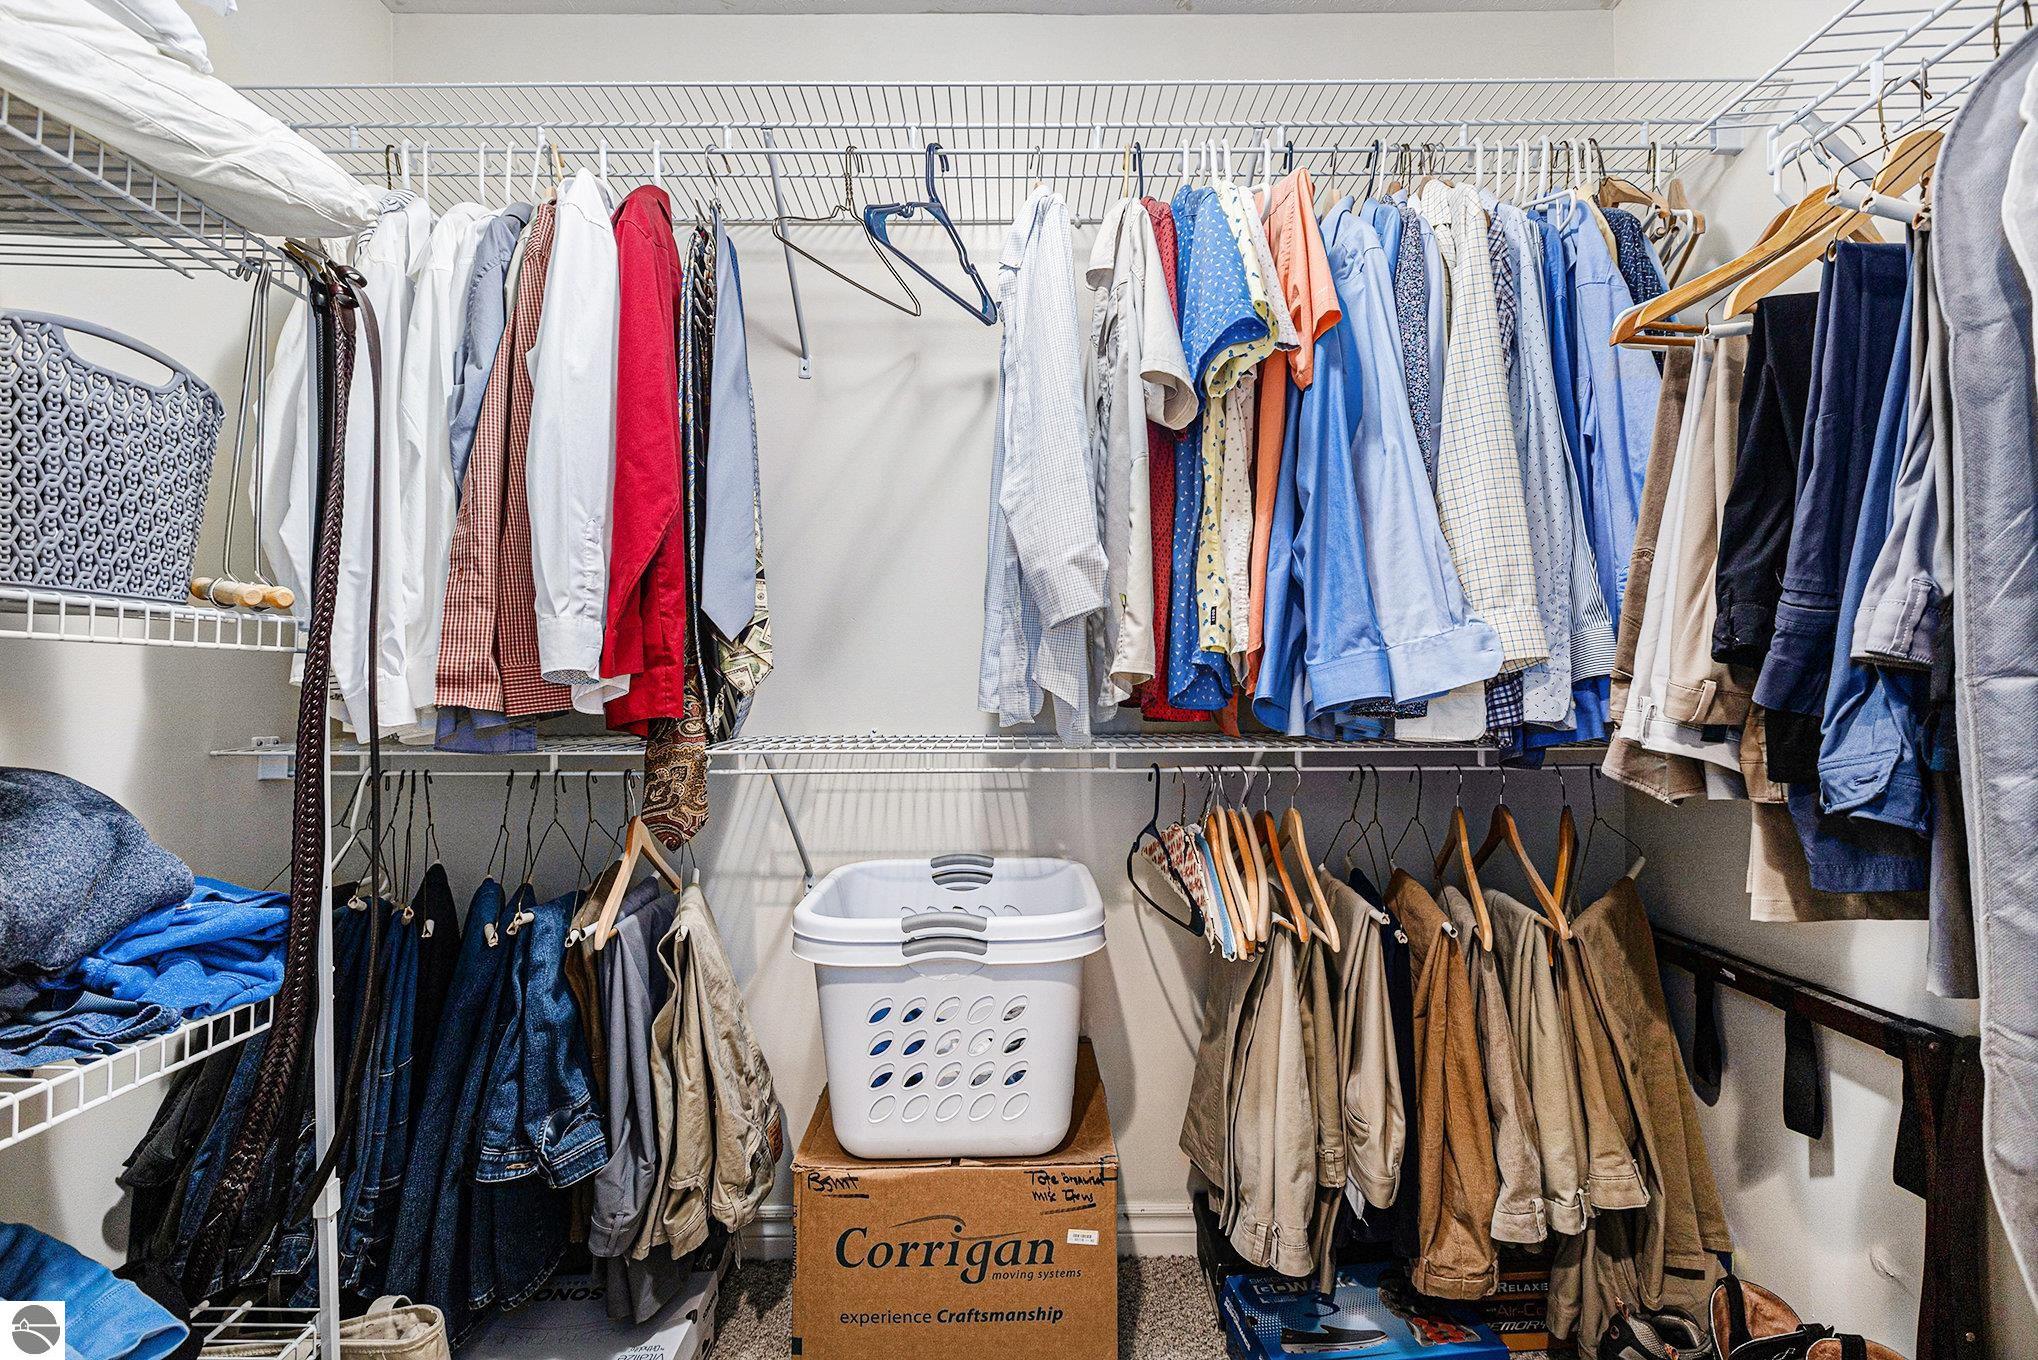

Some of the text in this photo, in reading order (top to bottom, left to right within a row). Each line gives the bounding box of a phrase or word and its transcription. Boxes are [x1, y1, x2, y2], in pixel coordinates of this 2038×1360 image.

[836, 1225, 1055, 1284] Corrigan
[991, 1268, 1082, 1282] moving systems
[1497, 1282, 1549, 1293] RELAXE
[839, 1307, 1063, 1327] experience Craftsmanship
